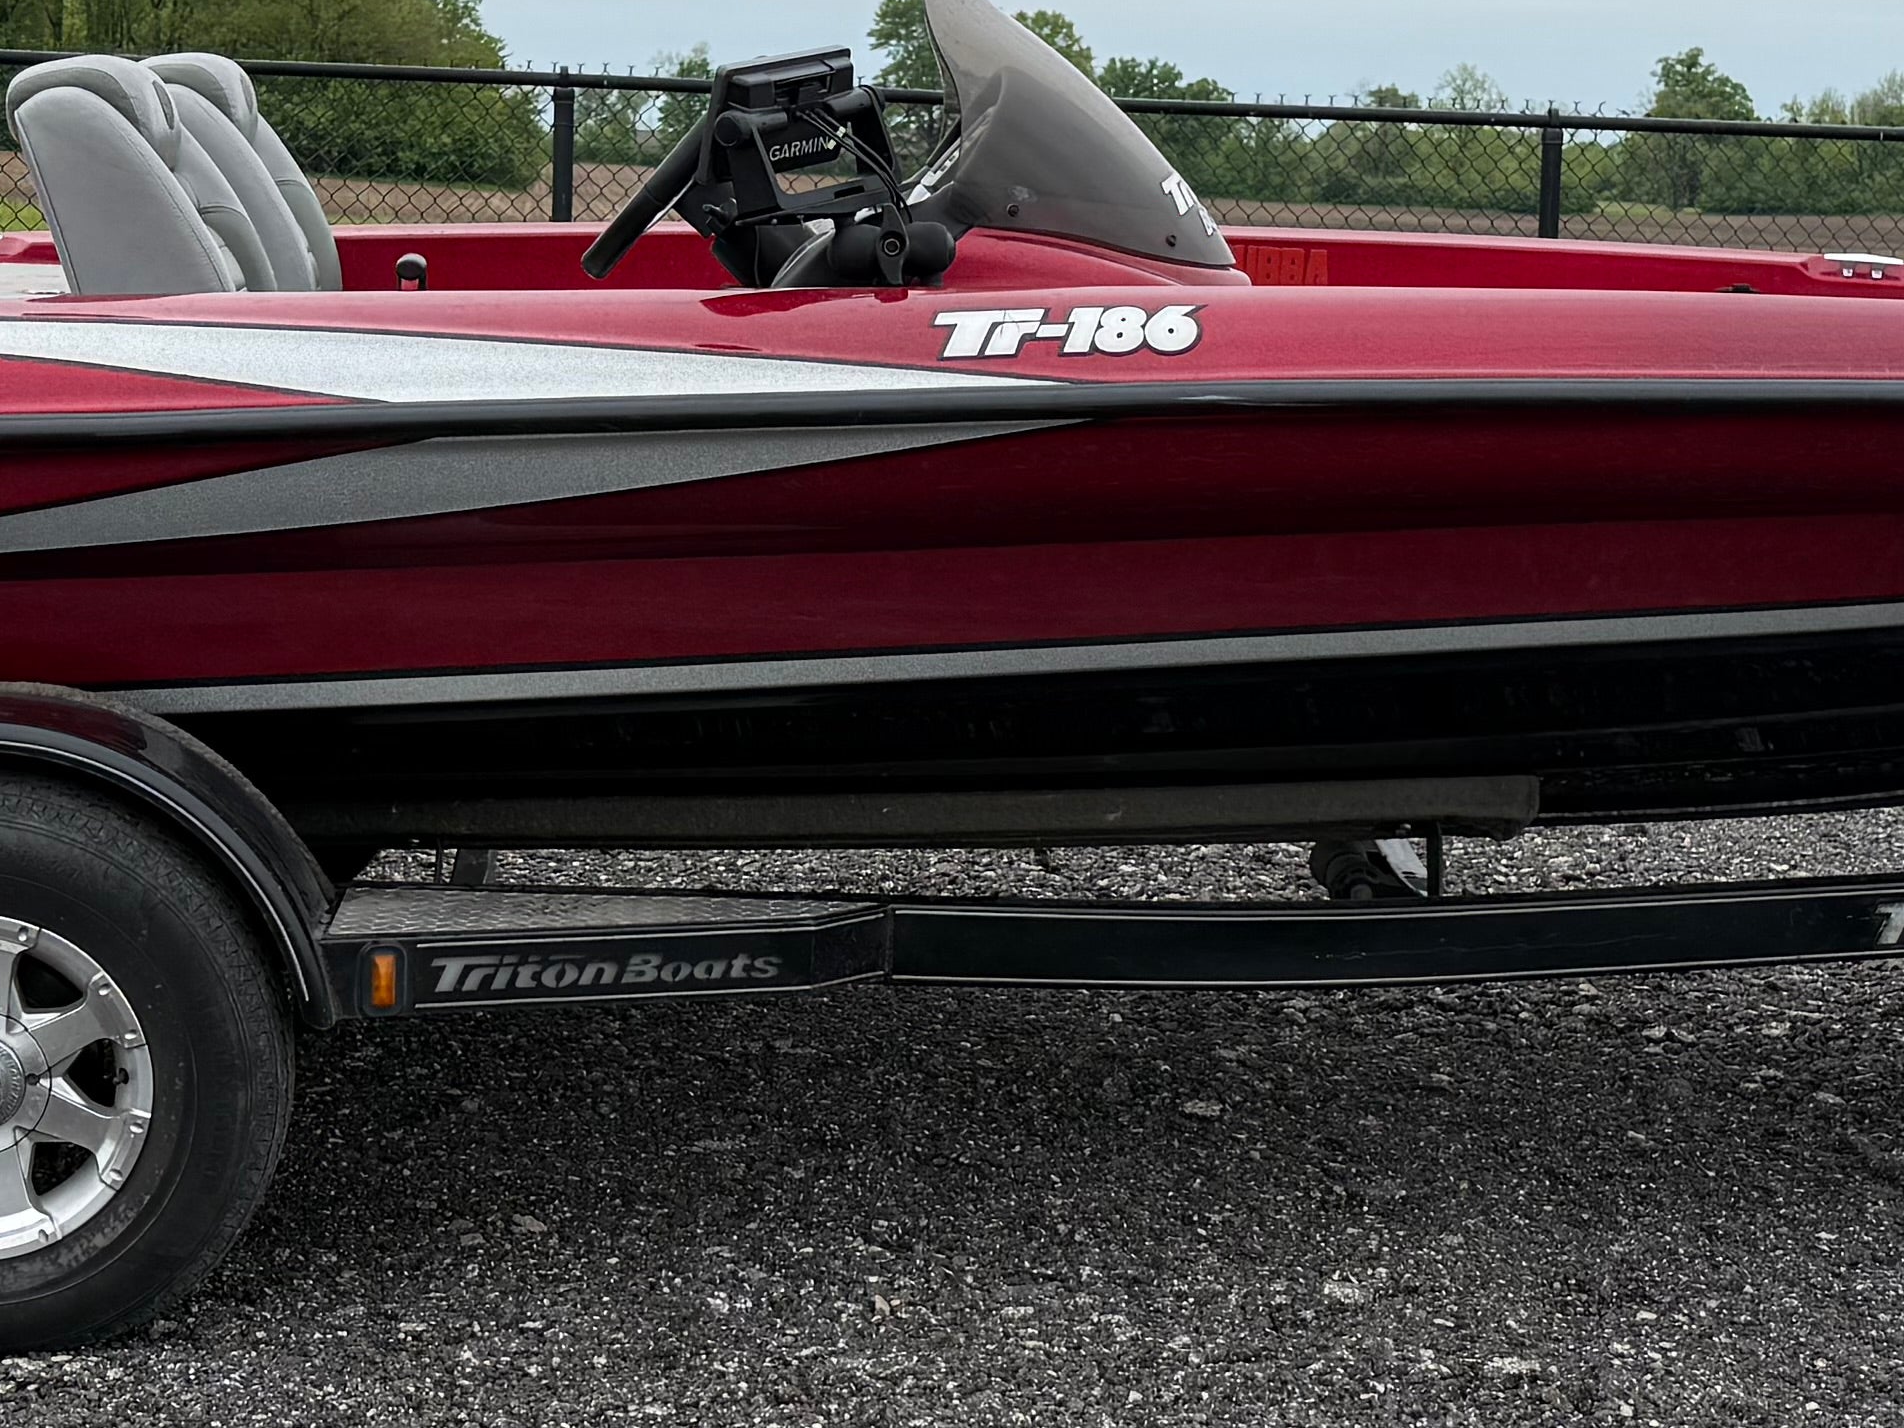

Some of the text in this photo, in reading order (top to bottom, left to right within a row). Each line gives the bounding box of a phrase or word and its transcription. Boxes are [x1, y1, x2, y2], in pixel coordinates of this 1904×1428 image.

[769, 136, 830, 162] GARMIN
[932, 304, 1208, 358] Tr-186
[430, 953, 783, 993] Triton Boats
